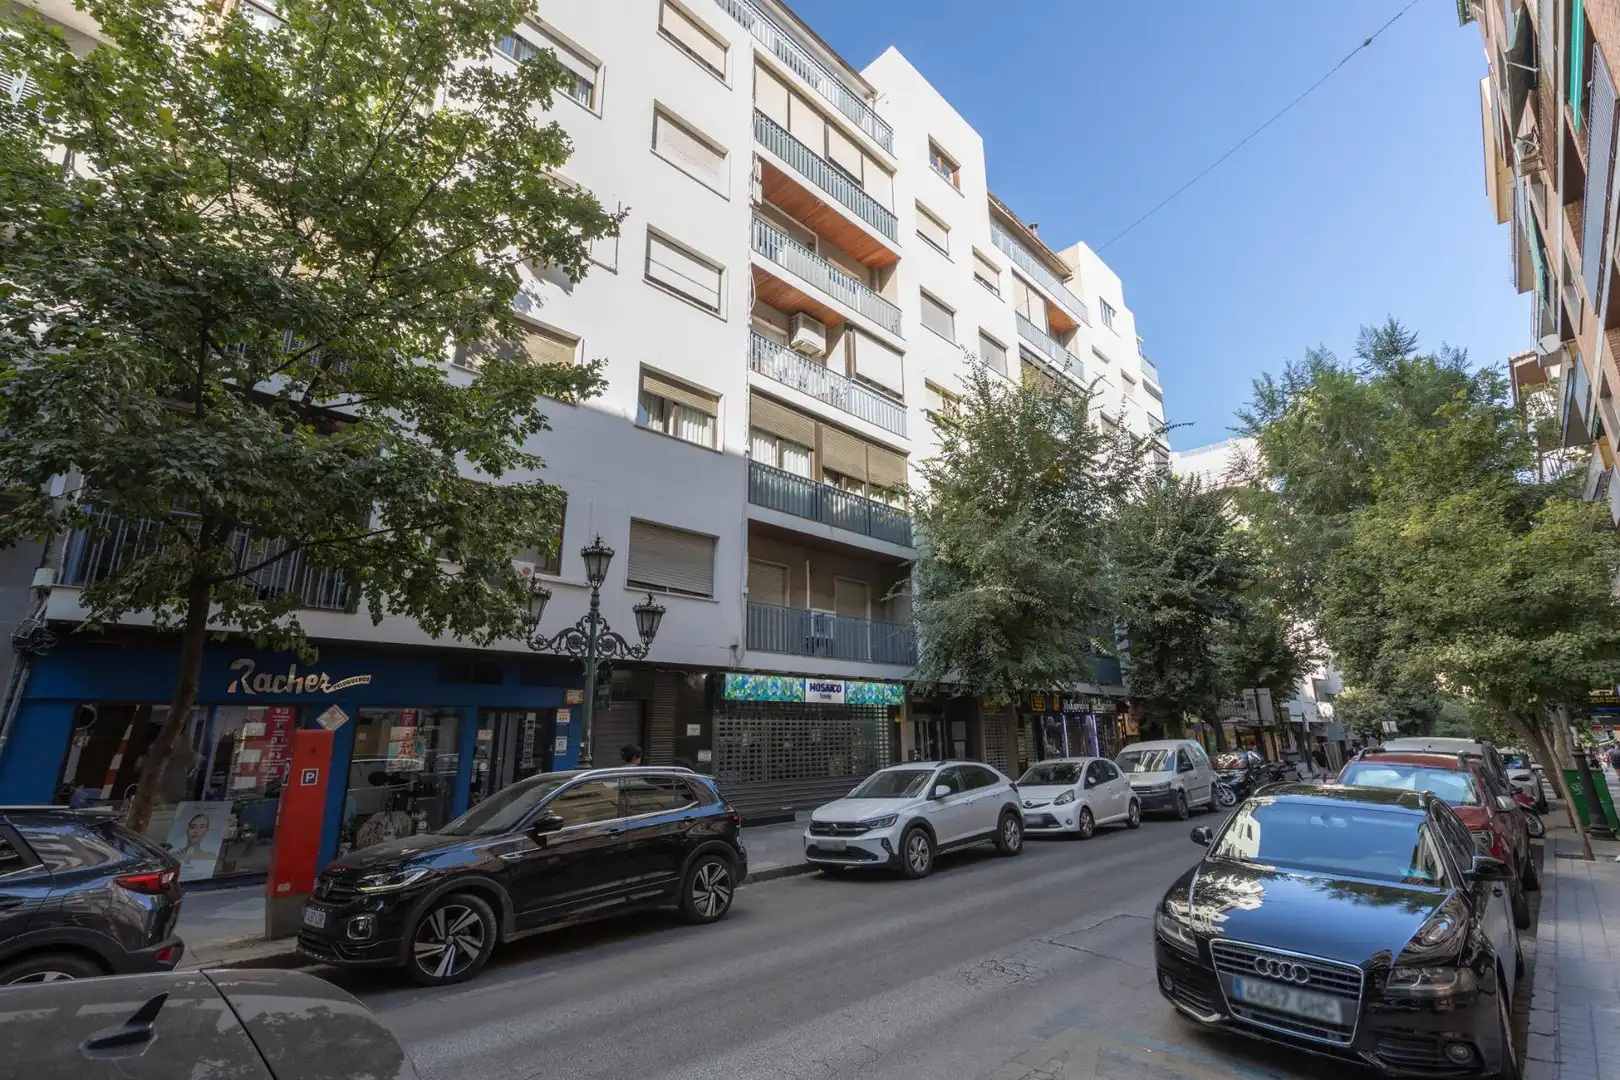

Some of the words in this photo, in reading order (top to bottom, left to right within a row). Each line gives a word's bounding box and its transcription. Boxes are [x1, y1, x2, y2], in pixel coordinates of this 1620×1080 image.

[227, 658, 333, 695] Racher
[809, 683, 842, 693] MOSAICO
[305, 772, 316, 783] P
